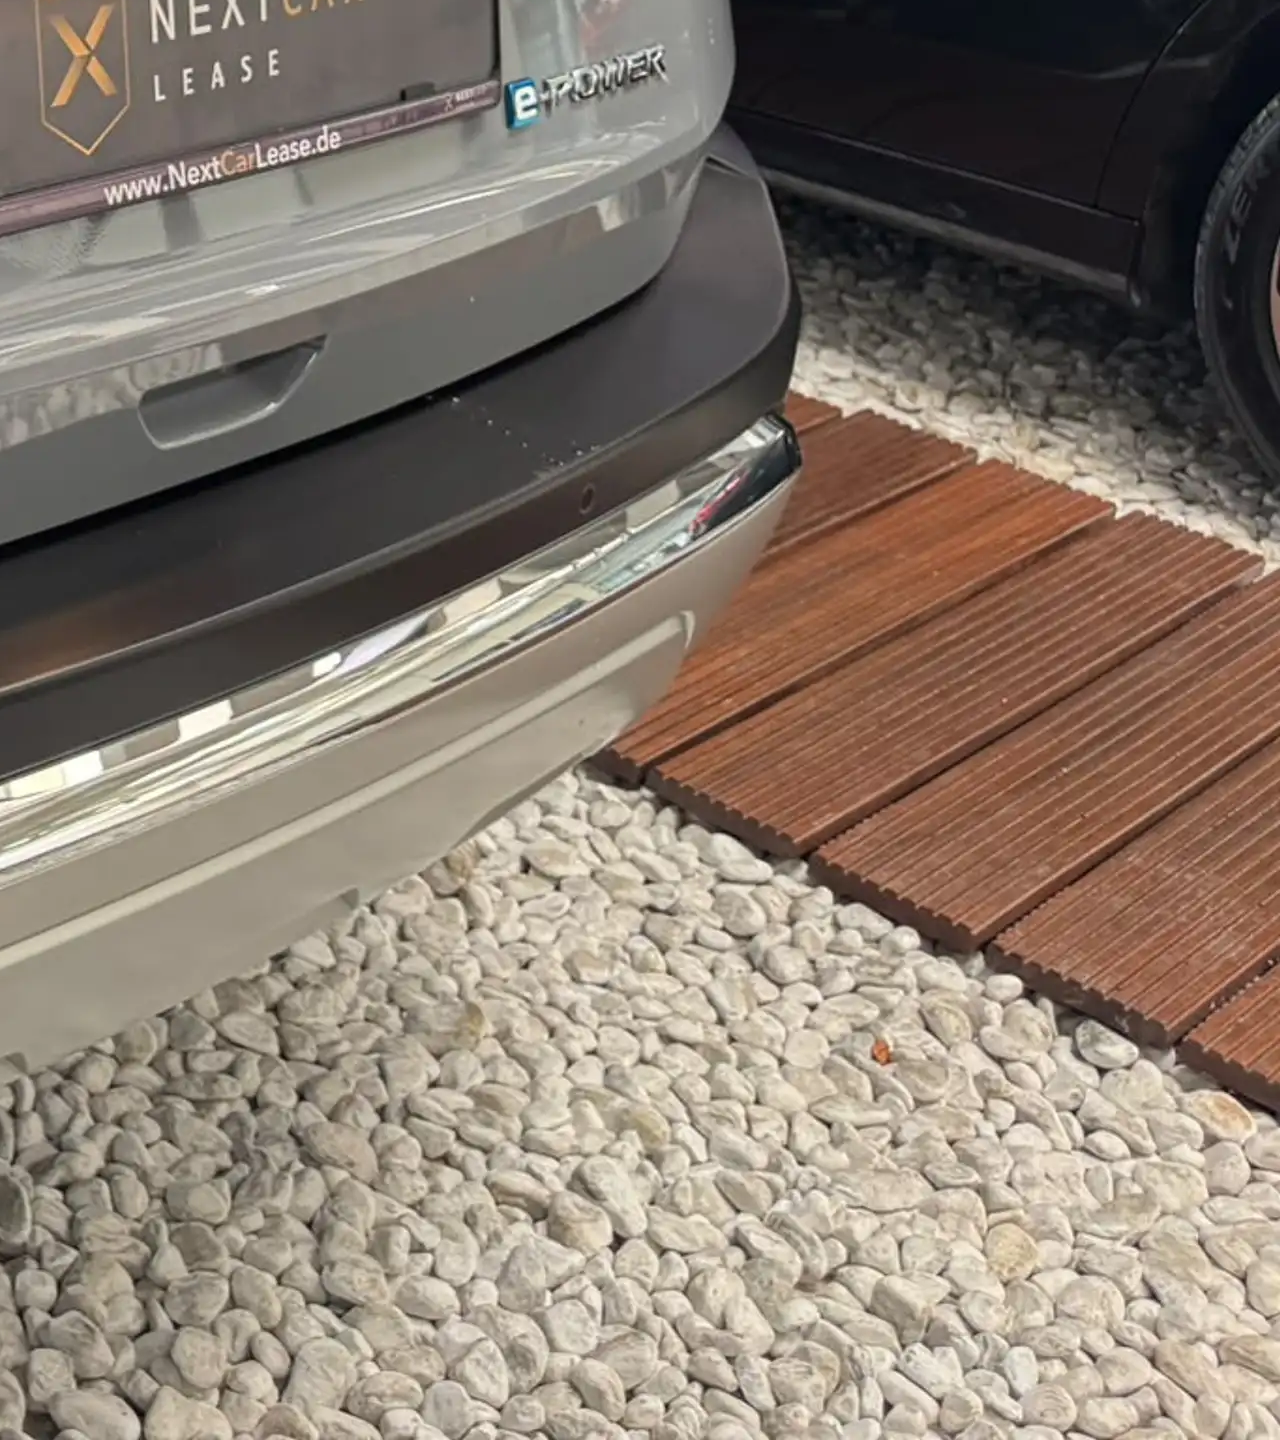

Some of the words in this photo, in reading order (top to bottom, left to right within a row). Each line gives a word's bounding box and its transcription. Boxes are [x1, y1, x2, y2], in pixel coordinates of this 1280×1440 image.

[153, 48, 280, 102] LEASE
[510, 43, 670, 124] e-POWER
[103, 125, 342, 206] www.NextCarLease.de
